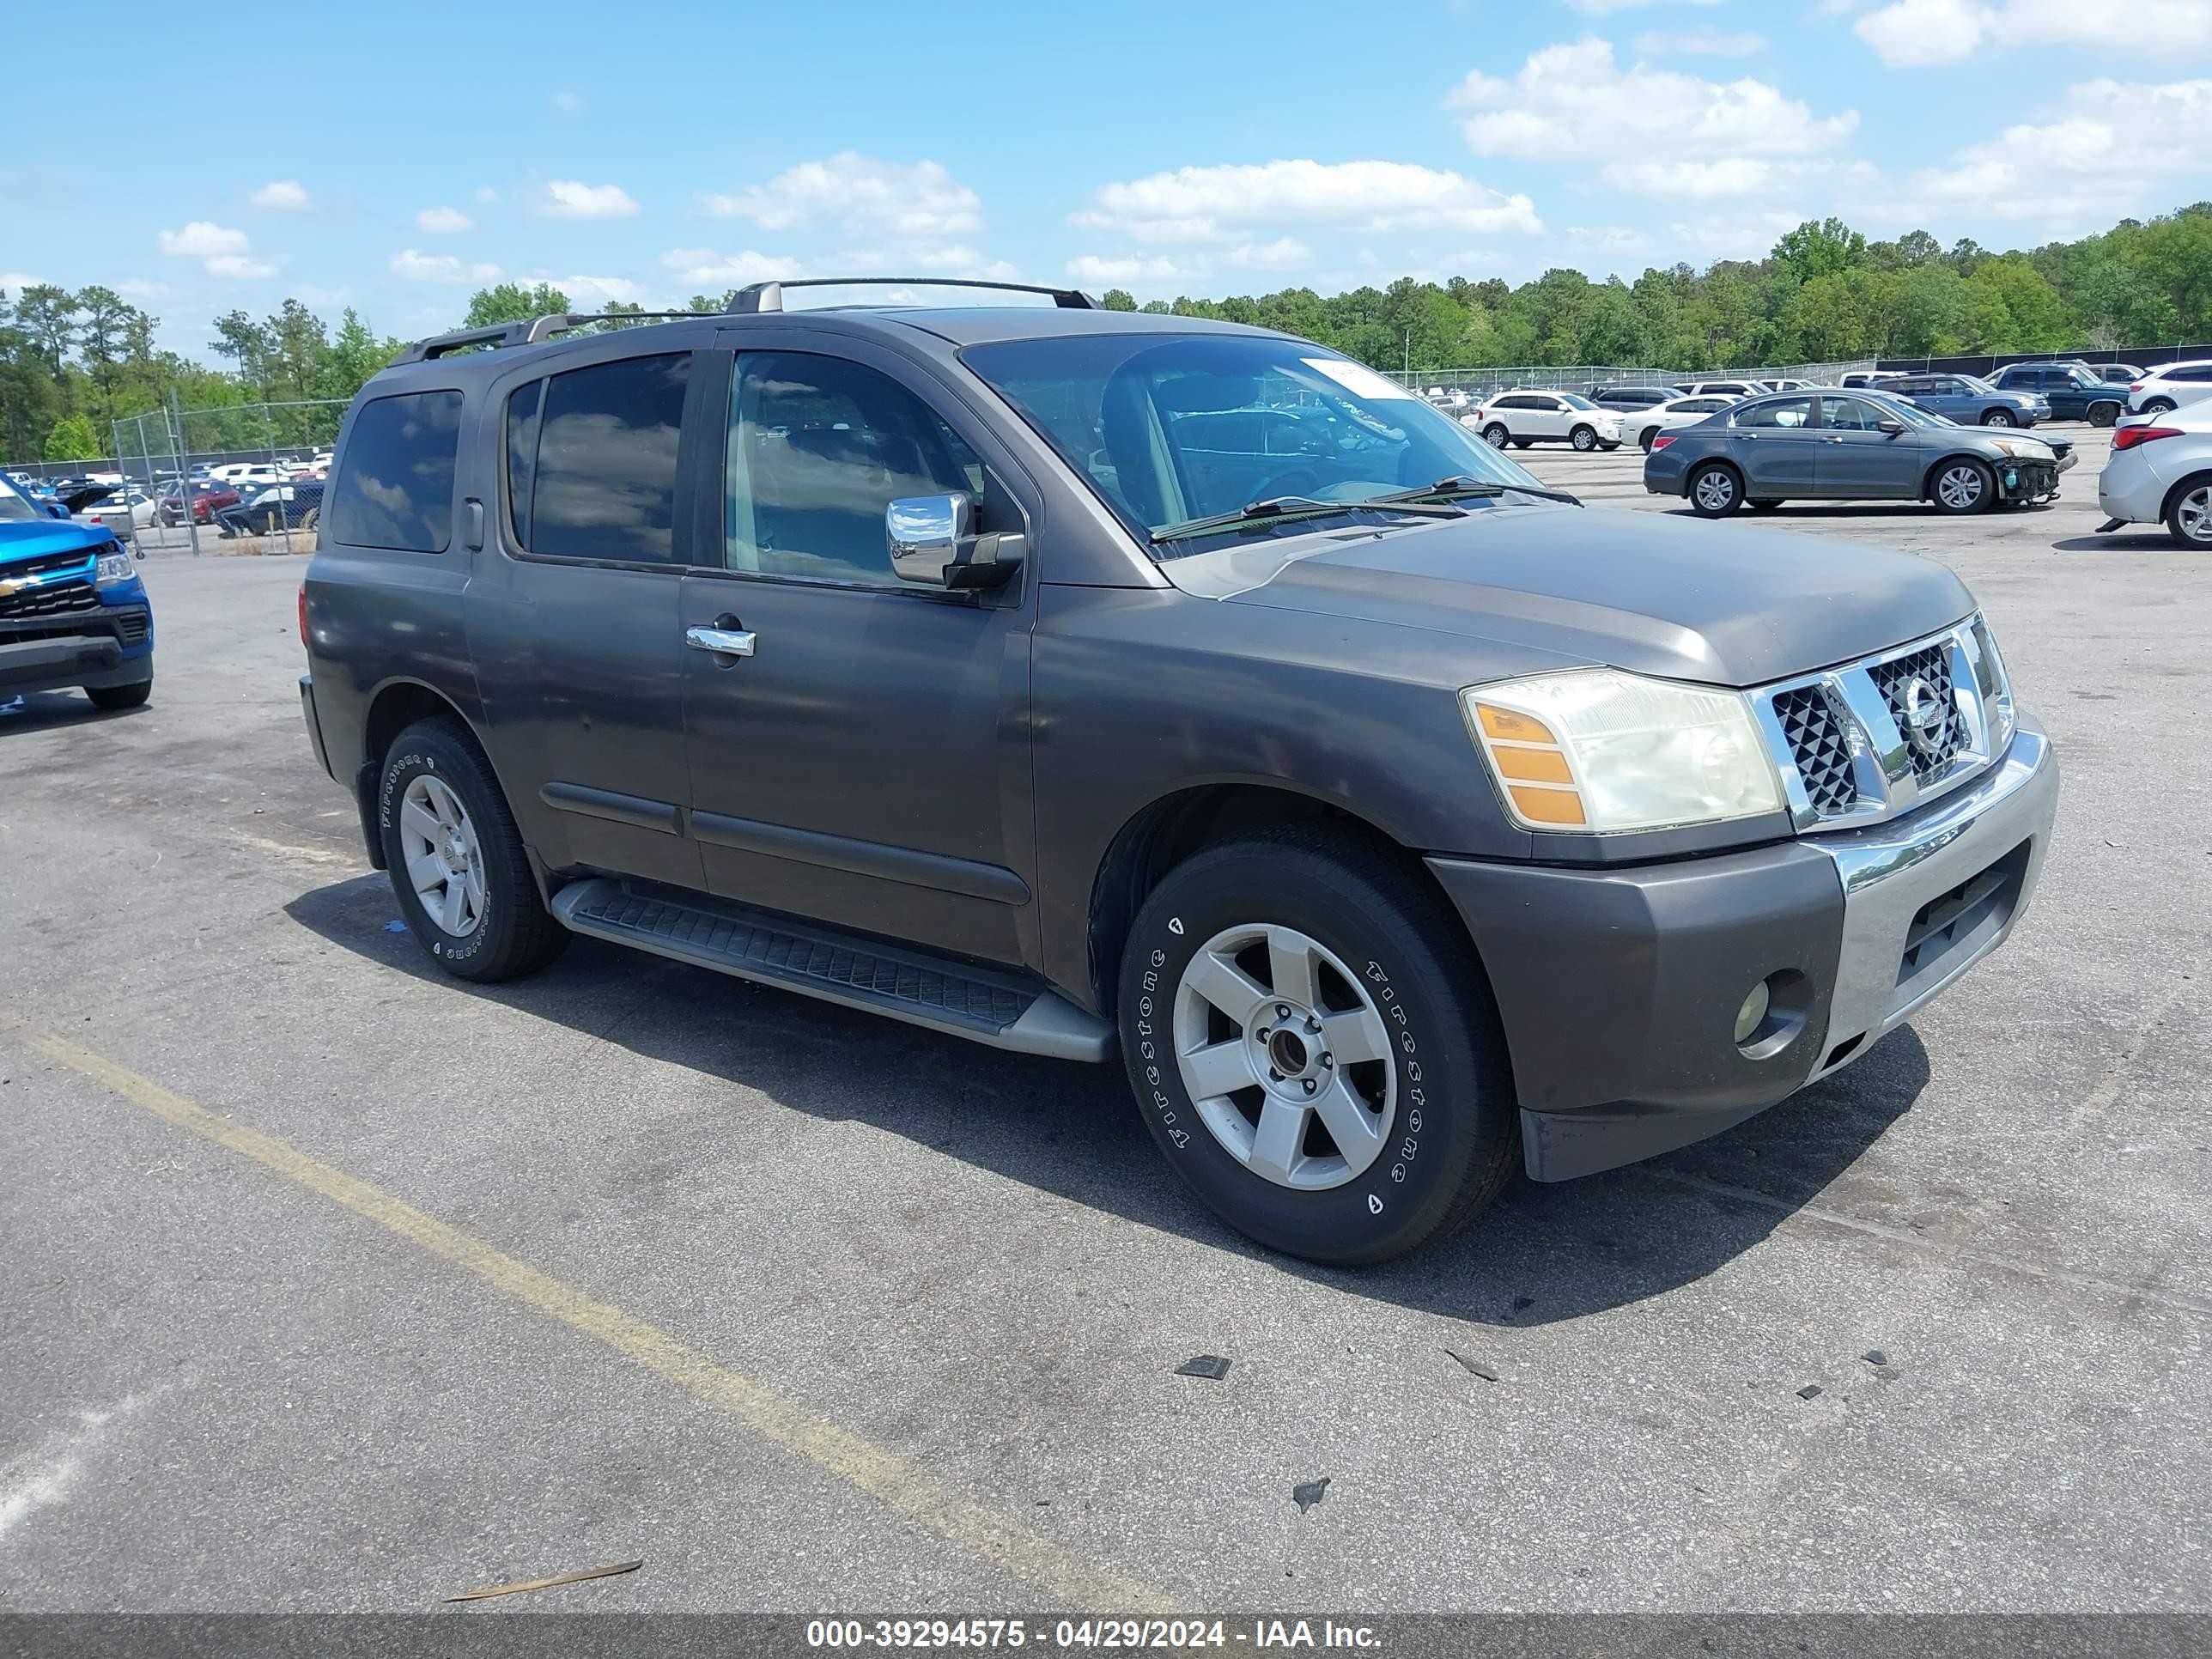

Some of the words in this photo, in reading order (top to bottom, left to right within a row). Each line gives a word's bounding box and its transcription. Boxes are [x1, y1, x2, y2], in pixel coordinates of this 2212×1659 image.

[381, 753, 422, 829] Firestone
[1138, 948, 1191, 1151] Firestone
[1365, 960, 1427, 1183] Firestone
